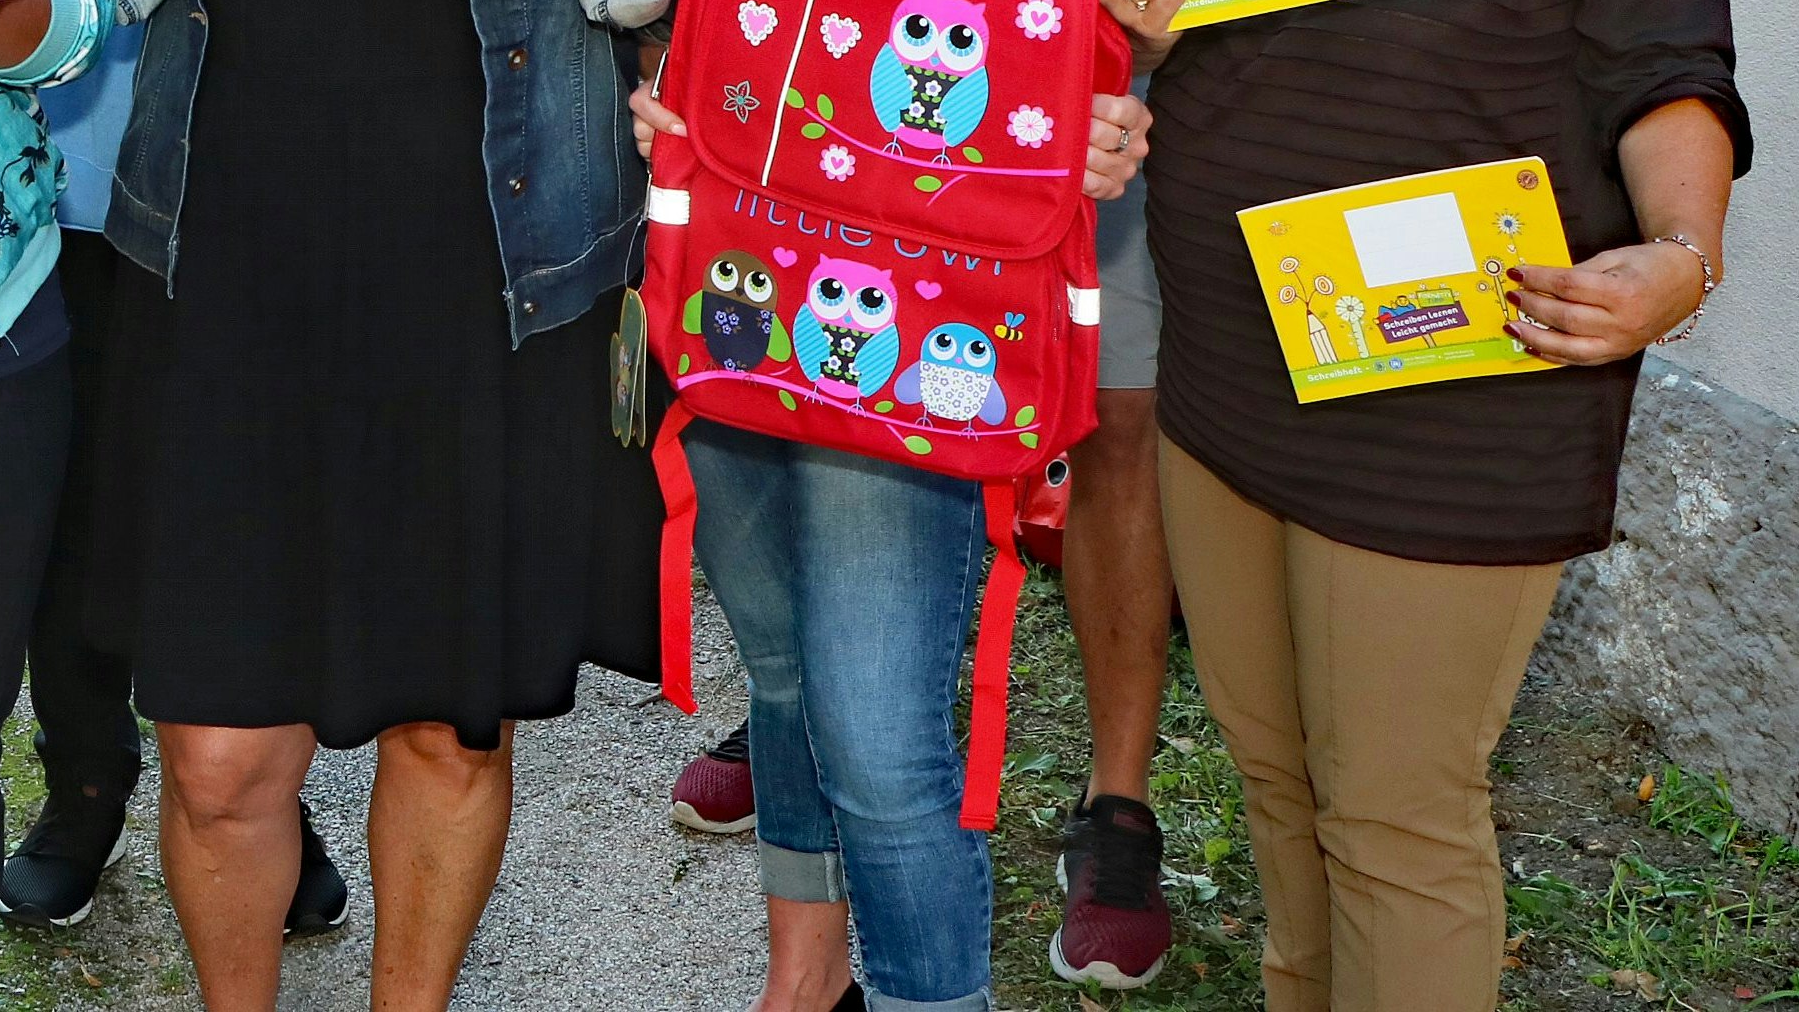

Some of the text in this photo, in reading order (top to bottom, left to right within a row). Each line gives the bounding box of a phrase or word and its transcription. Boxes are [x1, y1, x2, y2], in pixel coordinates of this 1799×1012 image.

[1383, 307, 1459, 330] Schreiben Lernen
[1391, 317, 1458, 338] Leicht gemacht
[1307, 366, 1363, 382] Schreibheft
